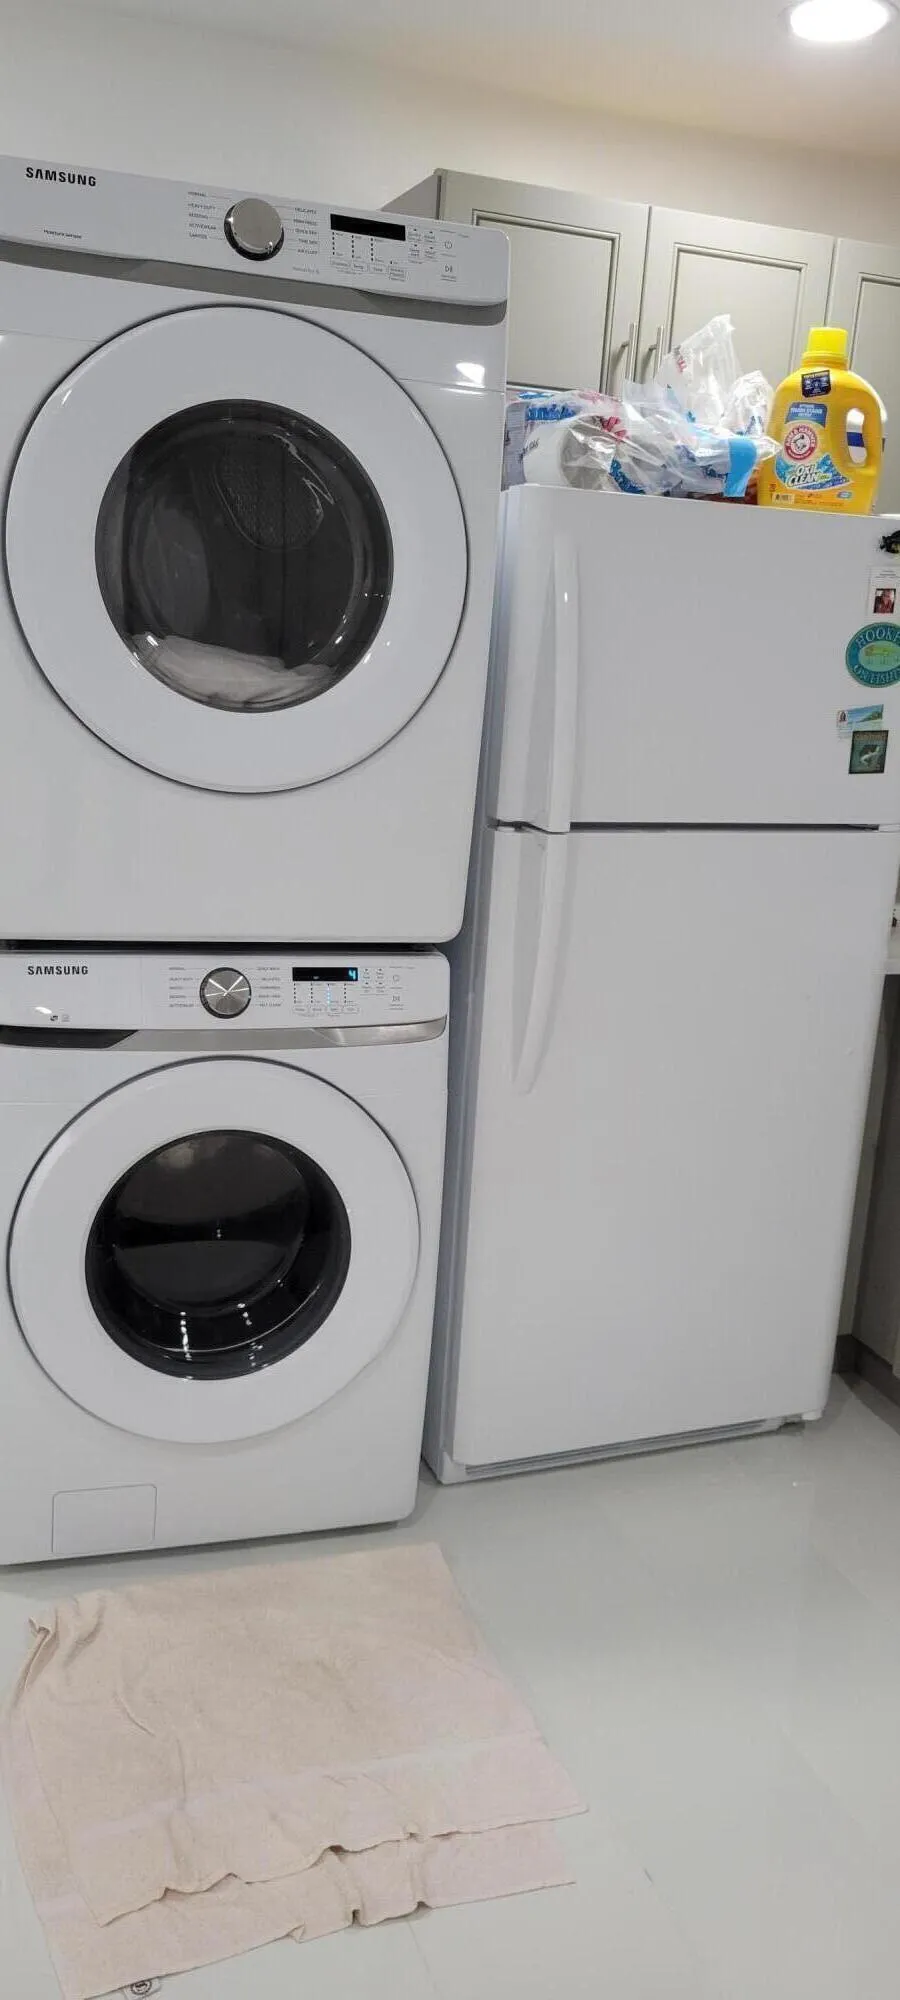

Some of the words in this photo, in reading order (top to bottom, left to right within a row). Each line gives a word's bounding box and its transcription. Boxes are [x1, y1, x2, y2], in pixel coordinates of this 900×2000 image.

[25, 167, 97, 187] SAMSUNG
[788, 472, 818, 487] CLEAN
[27, 965, 89, 976] SAMSUNG
[348, 969, 357, 980] 4
